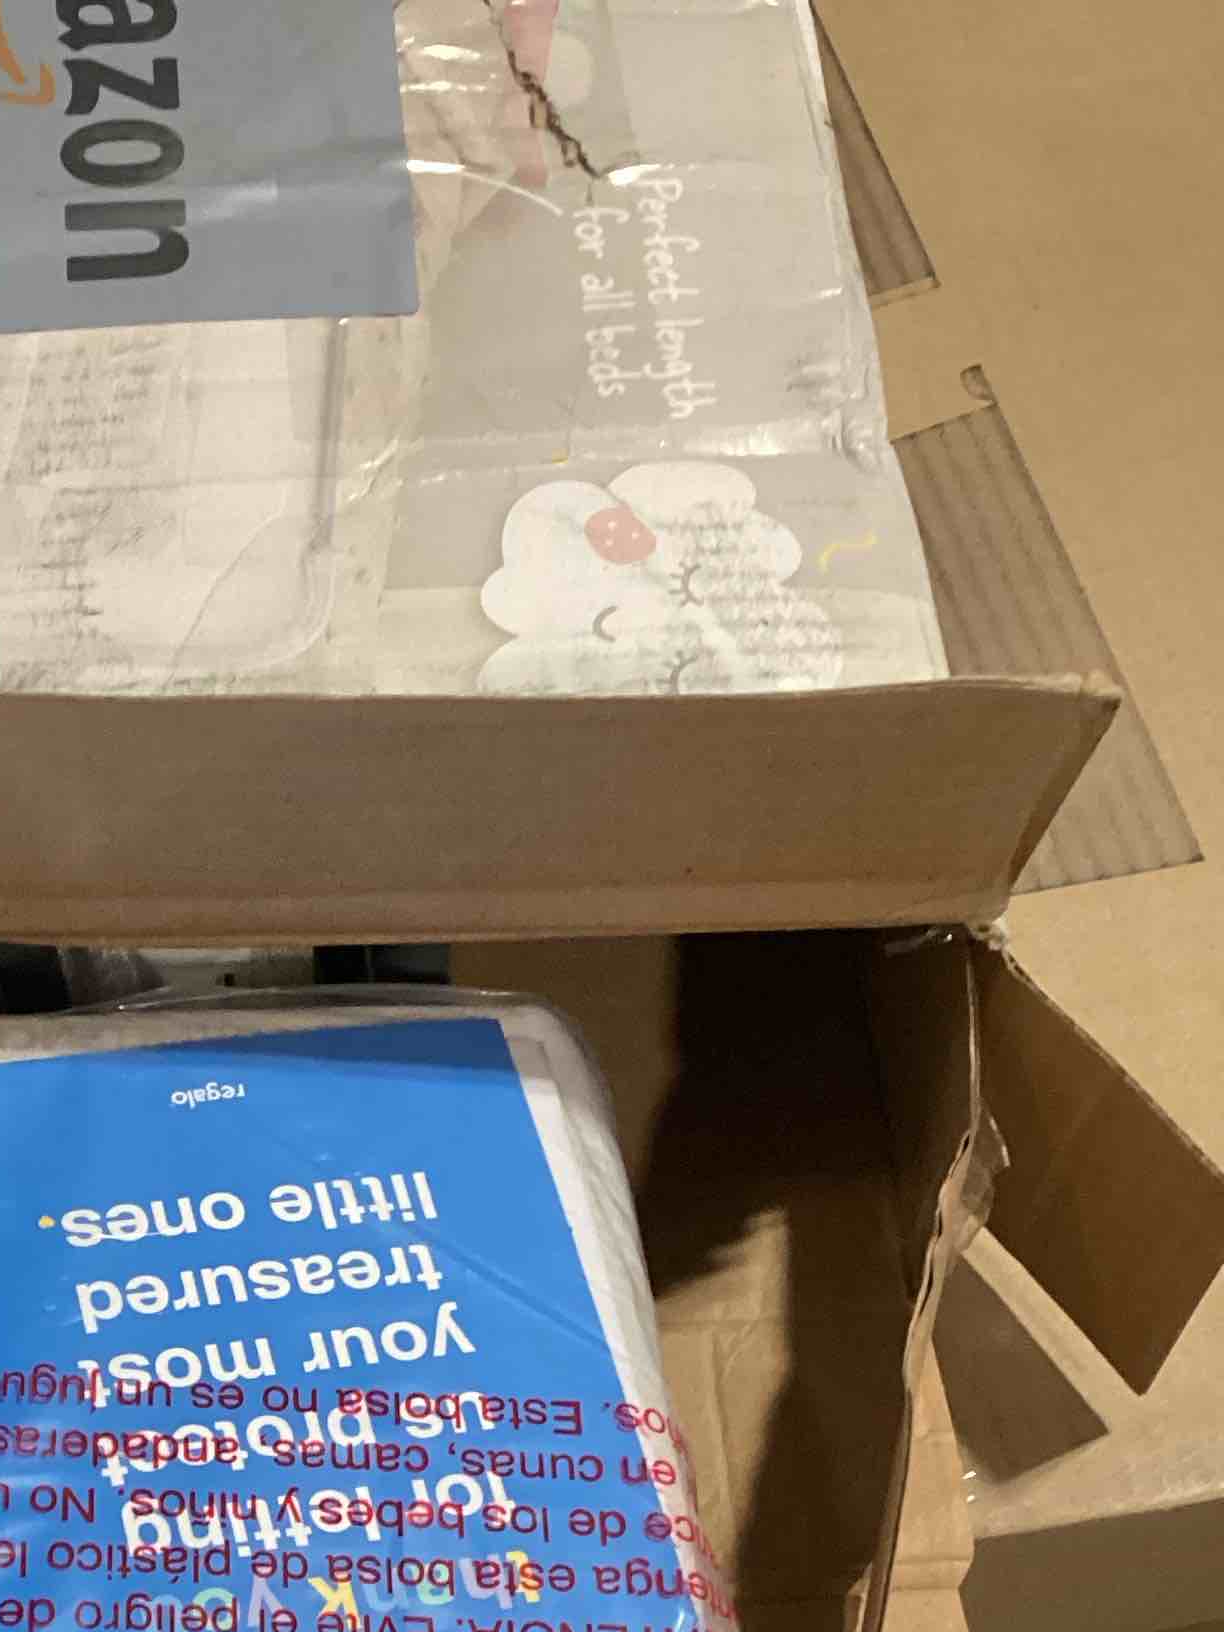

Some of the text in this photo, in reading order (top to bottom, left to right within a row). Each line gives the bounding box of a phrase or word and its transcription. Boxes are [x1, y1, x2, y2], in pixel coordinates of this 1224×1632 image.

[573, 207, 641, 398] for all beds
[634, 177, 718, 419] Perfect length
[170, 1081, 246, 1109] regalo
[270, 1171, 437, 1231] little
[76, 1243, 442, 1335] treasured
[77, 1301, 474, 1408] your most
[115, 1379, 171, 1406] un
[190, 1382, 244, 1410] es
[263, 1385, 317, 1415] no
[336, 1388, 460, 1427] bolsa
[477, 1397, 582, 1435] Esta
[98, 1391, 496, 1487] us protect
[259, 1435, 429, 1474] camas,
[448, 1443, 604, 1484] cunas,
[621, 1456, 675, 1487] en
[30, 1485, 94, 1522] No
[117, 1488, 257, 1525] niños.
[121, 1471, 515, 1557] for letting
[276, 1487, 301, 1525] y
[313, 1498, 464, 1537] bebes
[481, 1504, 549, 1541] los
[569, 1510, 626, 1545] de
[47, 1540, 231, 1583] plástico
[251, 1551, 308, 1587] de
[326, 1555, 455, 1596] bolsa
[473, 1560, 575, 1598] esta
